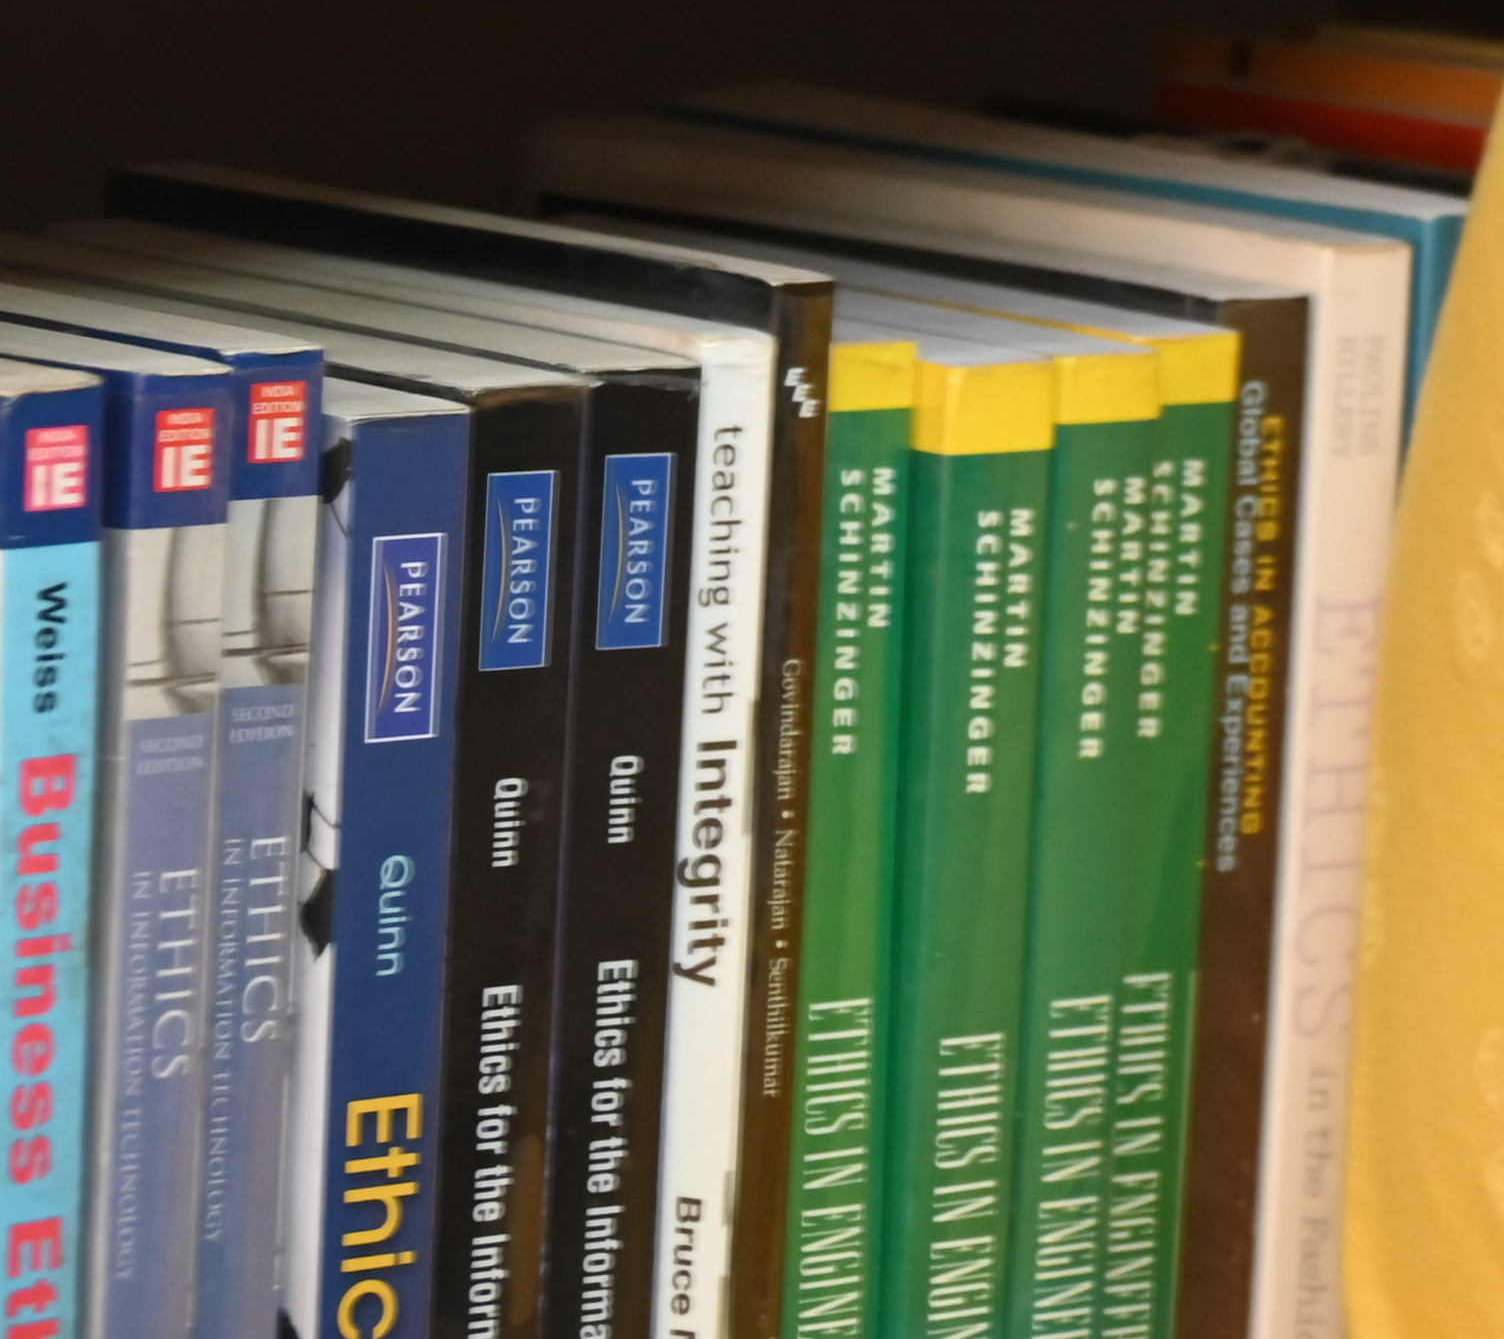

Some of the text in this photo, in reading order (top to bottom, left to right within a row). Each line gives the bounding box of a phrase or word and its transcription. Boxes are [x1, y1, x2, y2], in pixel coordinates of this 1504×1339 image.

[506, 495, 543, 645] PEARSON
[623, 478, 660, 628] PEARSON
[831, 469, 865, 757] SCHINZINGER
[868, 467, 897, 630] MARTIN
[1003, 508, 1035, 669] MARTIN
[1079, 478, 1118, 760] SCHINZINGER
[1116, 476, 1146, 635] MARTIN
[1136, 460, 1176, 739] SCHINZINGER
[1174, 459, 1206, 617] MARTIN
[1216, 380, 1268, 873] Global Cases and Experiences
[1238, 416, 1285, 838] ETHICS IN ACCOUNTING
[33, 580, 69, 715] Weiss
[394, 559, 428, 718] PEARSON
[672, 424, 743, 989] teaching with Integrity
[965, 510, 1003, 794] SCHINZINGER
[492, 776, 529, 869] Quinn
[607, 753, 646, 847] Quinn
[762, 658, 802, 1099] Govindarajan Natarajan Senthilkumar
[9, 753, 78, 1185] Business
[151, 867, 199, 1081] ETHICS
[214, 838, 245, 1061] IN INFORMATION
[240, 835, 288, 1045] ETHICS
[376, 853, 416, 977] Quinn
[116, 871, 153, 1282] IN INFORMATION TECHNOLOGY
[471, 983, 524, 1223] Ethics for the
[586, 959, 640, 1194] Ethics for the
[803, 997, 873, 1191] ETHICS IN
[932, 1032, 1006, 1223] ETHICS IN
[1041, 995, 1113, 1183] ETHICS IN
[1113, 971, 1171, 1157] ETHICS IN
[668, 1195, 704, 1317] Bruce
[1303, 1123, 1336, 1199] the
